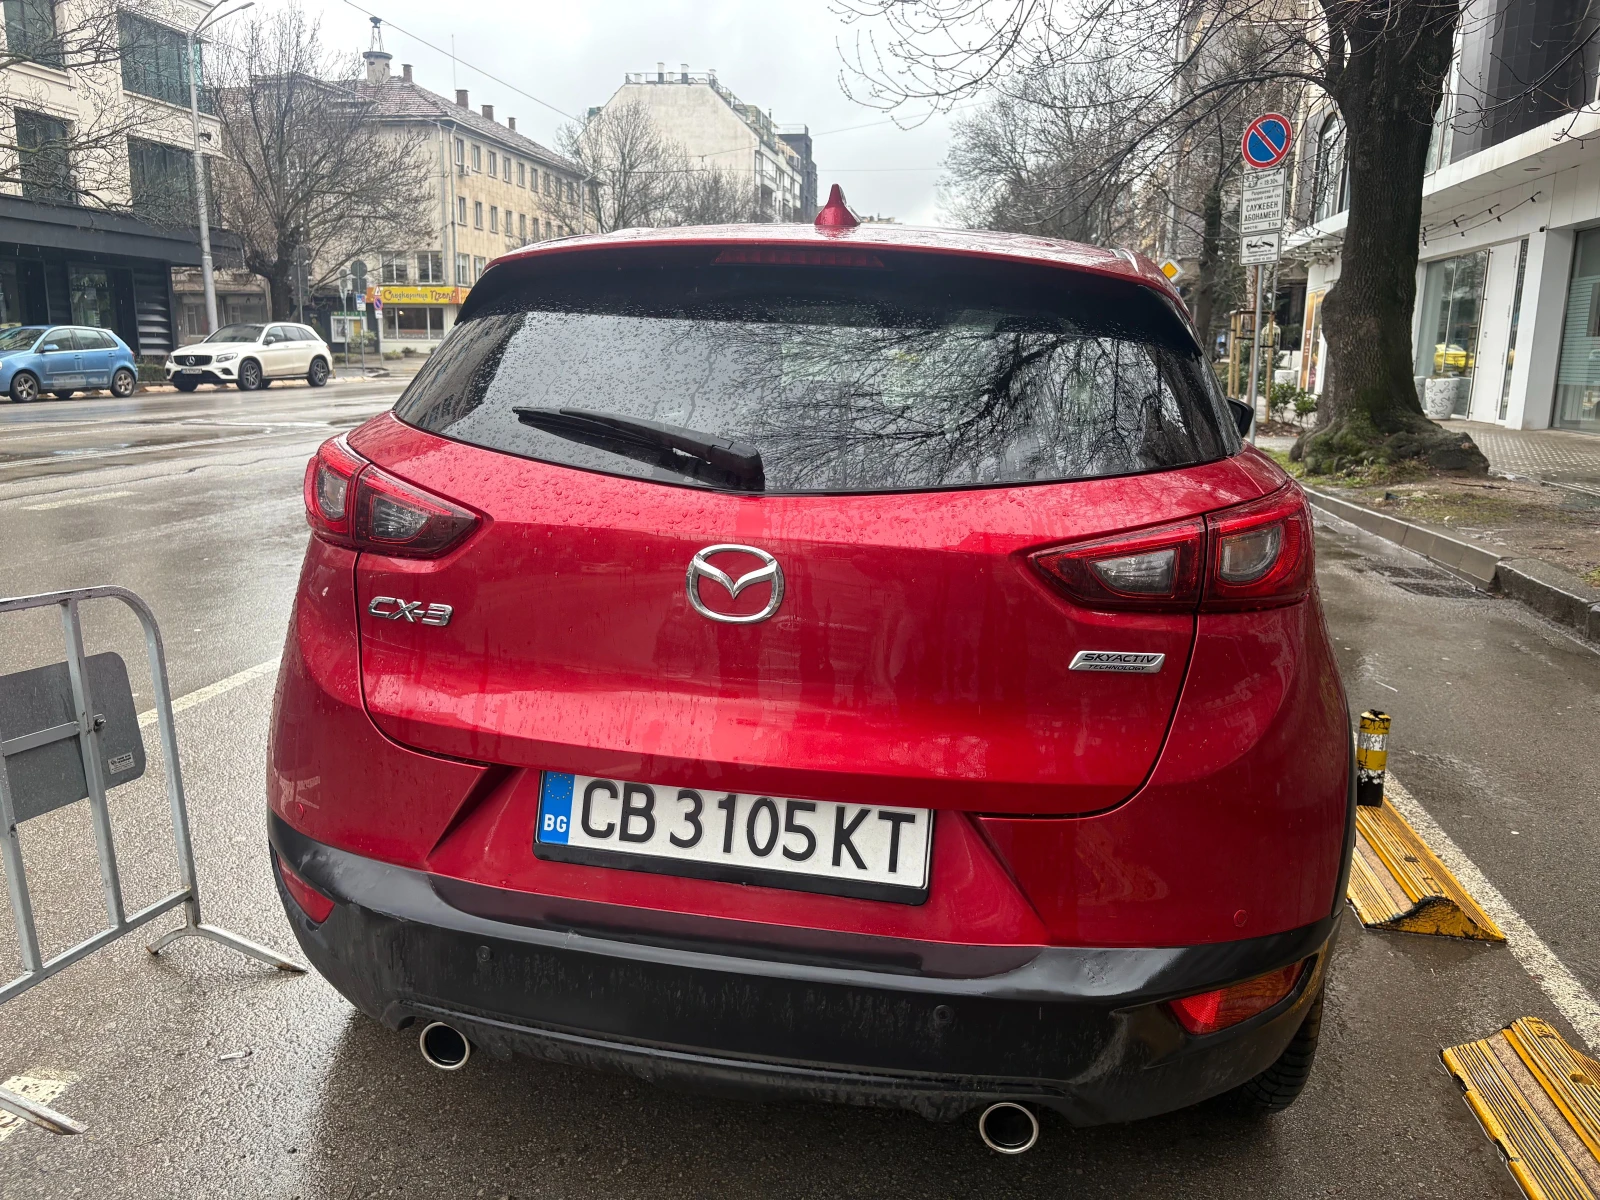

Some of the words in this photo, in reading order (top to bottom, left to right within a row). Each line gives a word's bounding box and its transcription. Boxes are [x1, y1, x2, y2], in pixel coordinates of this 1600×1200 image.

[1246, 201, 1279, 212] СЛУЖЕБЕН
[1244, 210, 1280, 222] АБОНАМЕНТ
[367, 595, 453, 627] CX-3
[1082, 653, 1157, 663] SKYACTIV
[543, 813, 568, 833] BG
[581, 778, 657, 844] CB
[669, 787, 817, 862] 3105
[831, 805, 916, 874] KT
